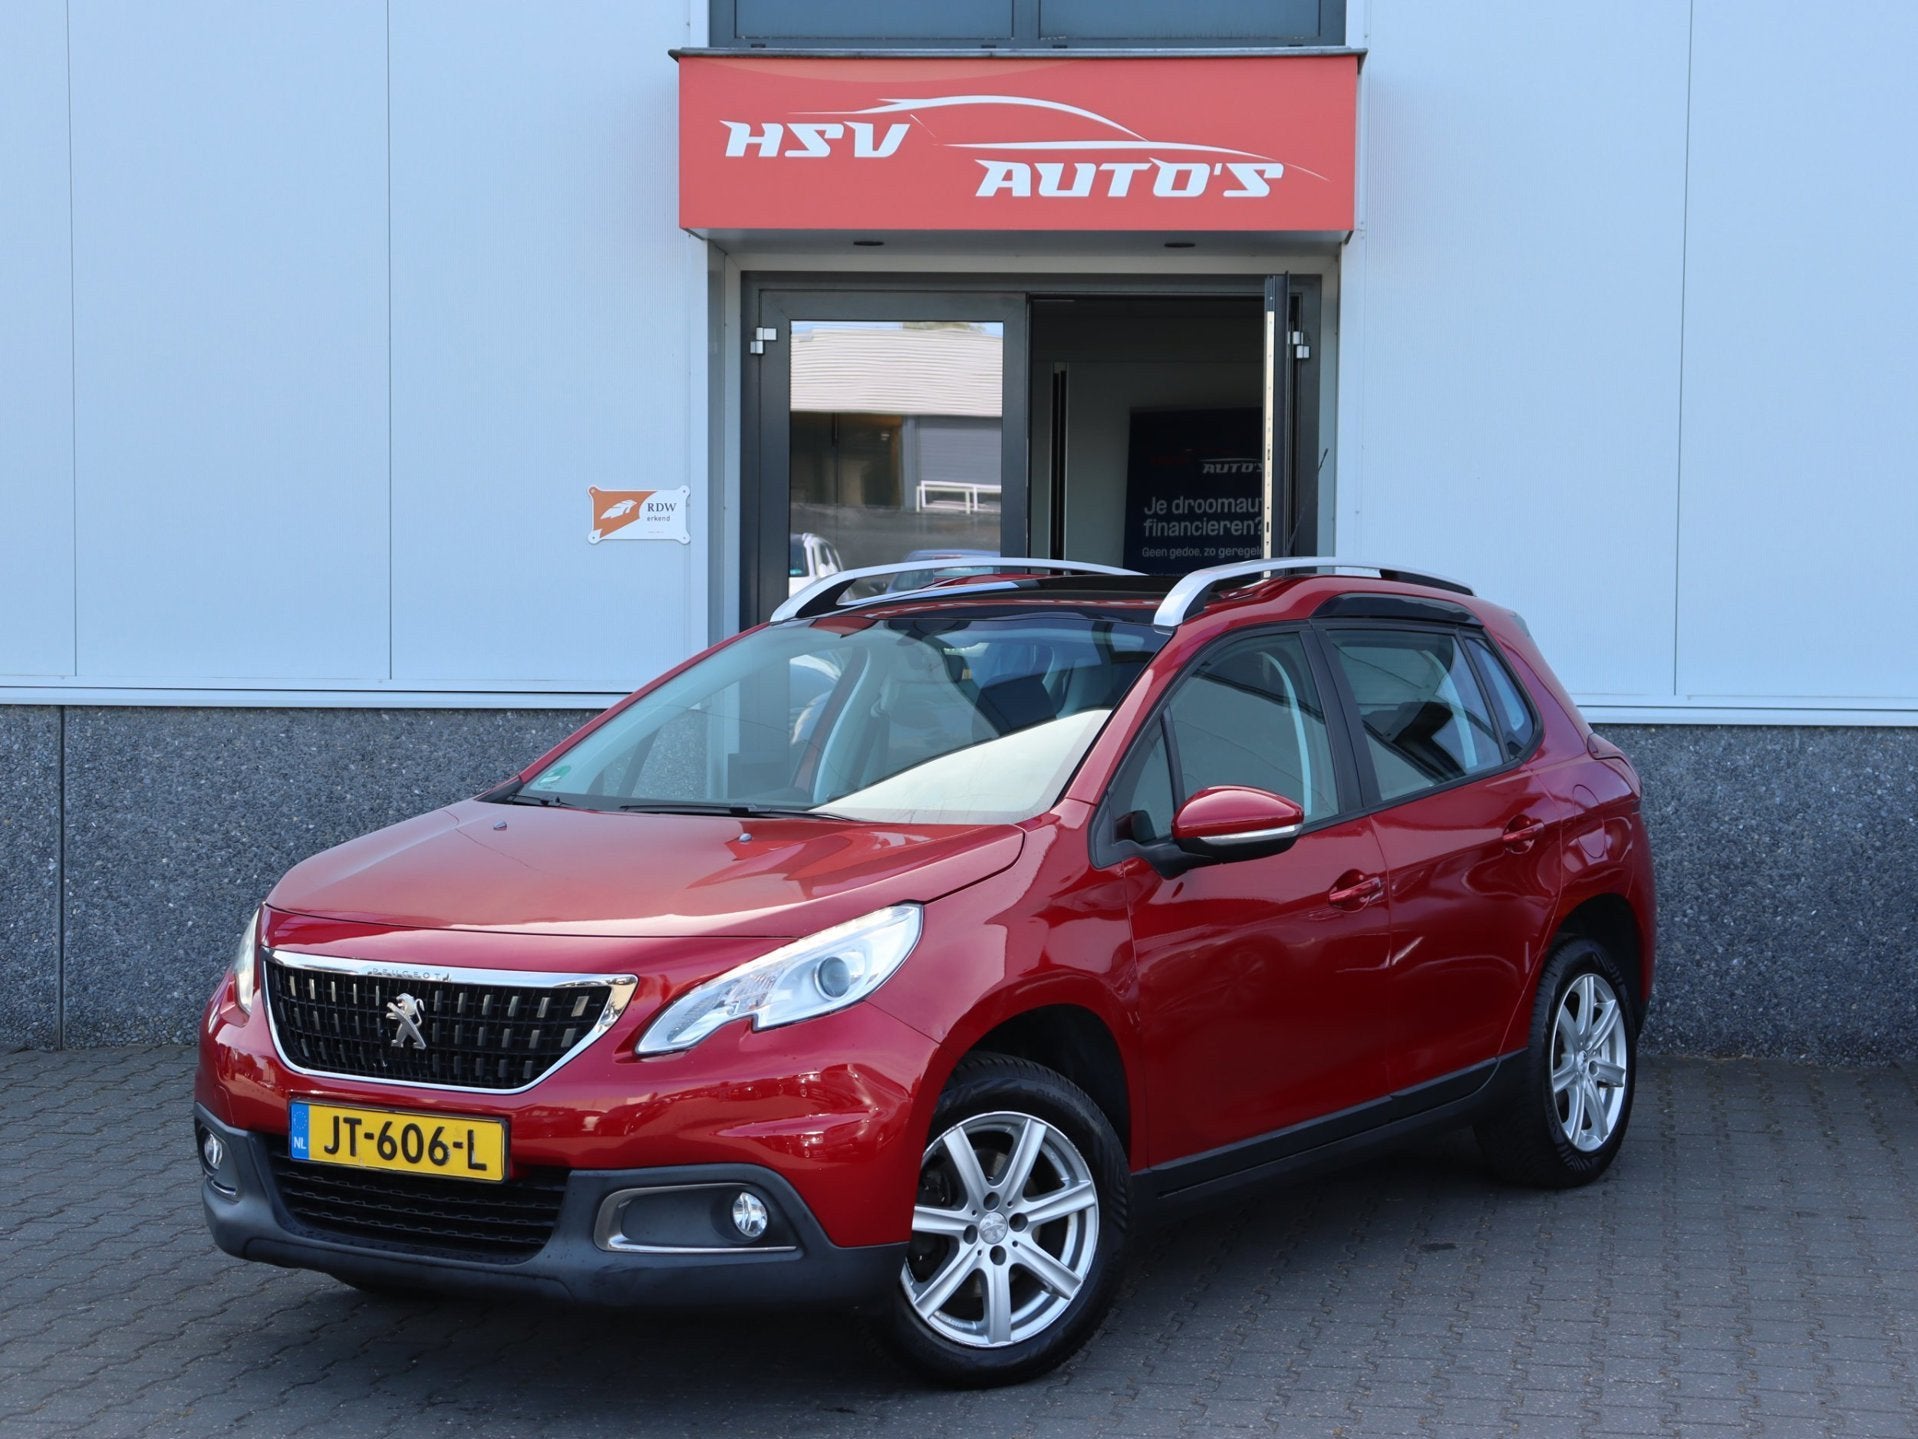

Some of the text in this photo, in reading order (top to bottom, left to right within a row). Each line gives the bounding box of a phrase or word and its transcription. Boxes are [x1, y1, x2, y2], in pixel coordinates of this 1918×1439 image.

[720, 120, 911, 158] HSV
[974, 157, 1285, 198] AUTO'S
[647, 502, 677, 513] RDW
[1144, 497, 1167, 515] Je
[1142, 547, 1168, 557] Geen
[1203, 548, 1217, 556] zo
[293, 1136, 307, 1150] NL
[324, 1115, 488, 1172] JT-606-L
